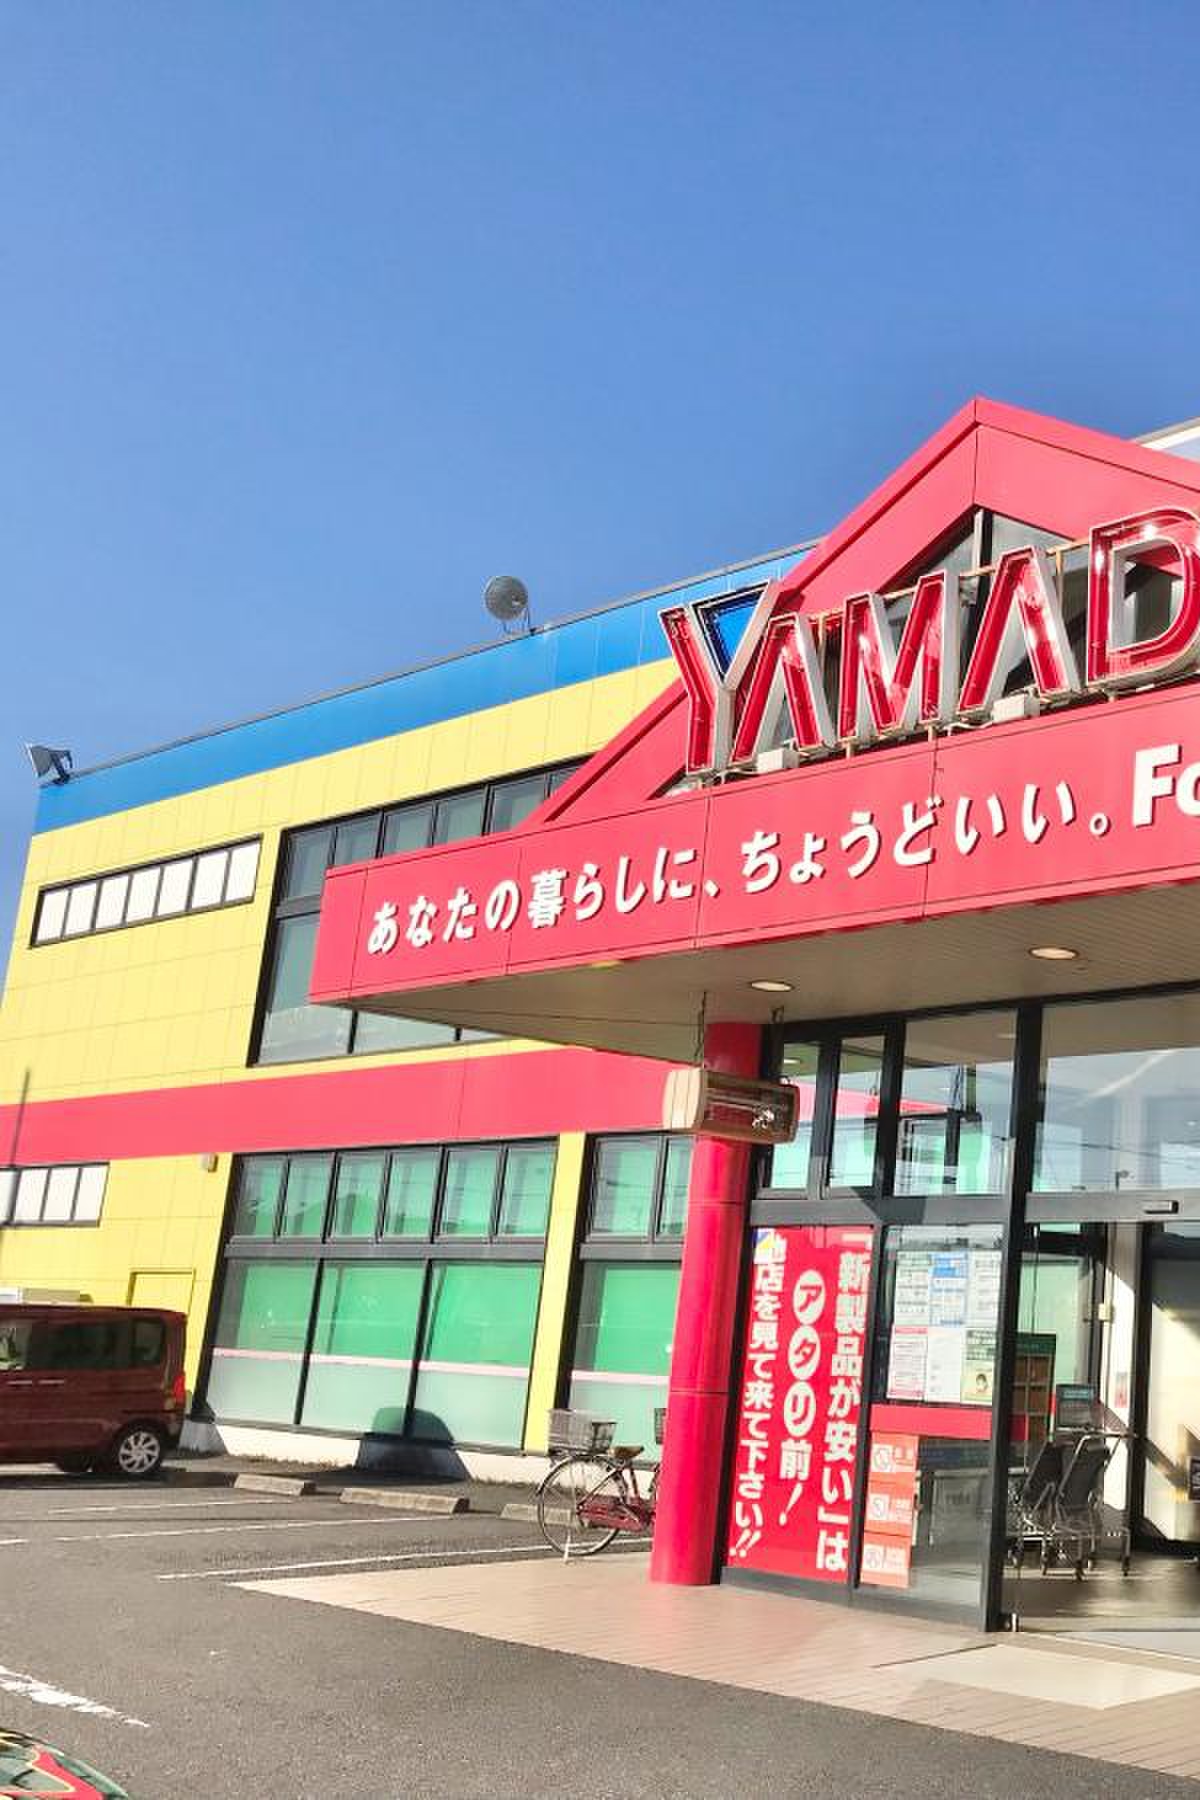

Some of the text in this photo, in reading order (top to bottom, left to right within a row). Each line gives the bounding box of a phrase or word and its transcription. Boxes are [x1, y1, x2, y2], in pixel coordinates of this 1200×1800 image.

[367, 780, 1111, 956] あなたの暮らしに、ちょうどいい。
